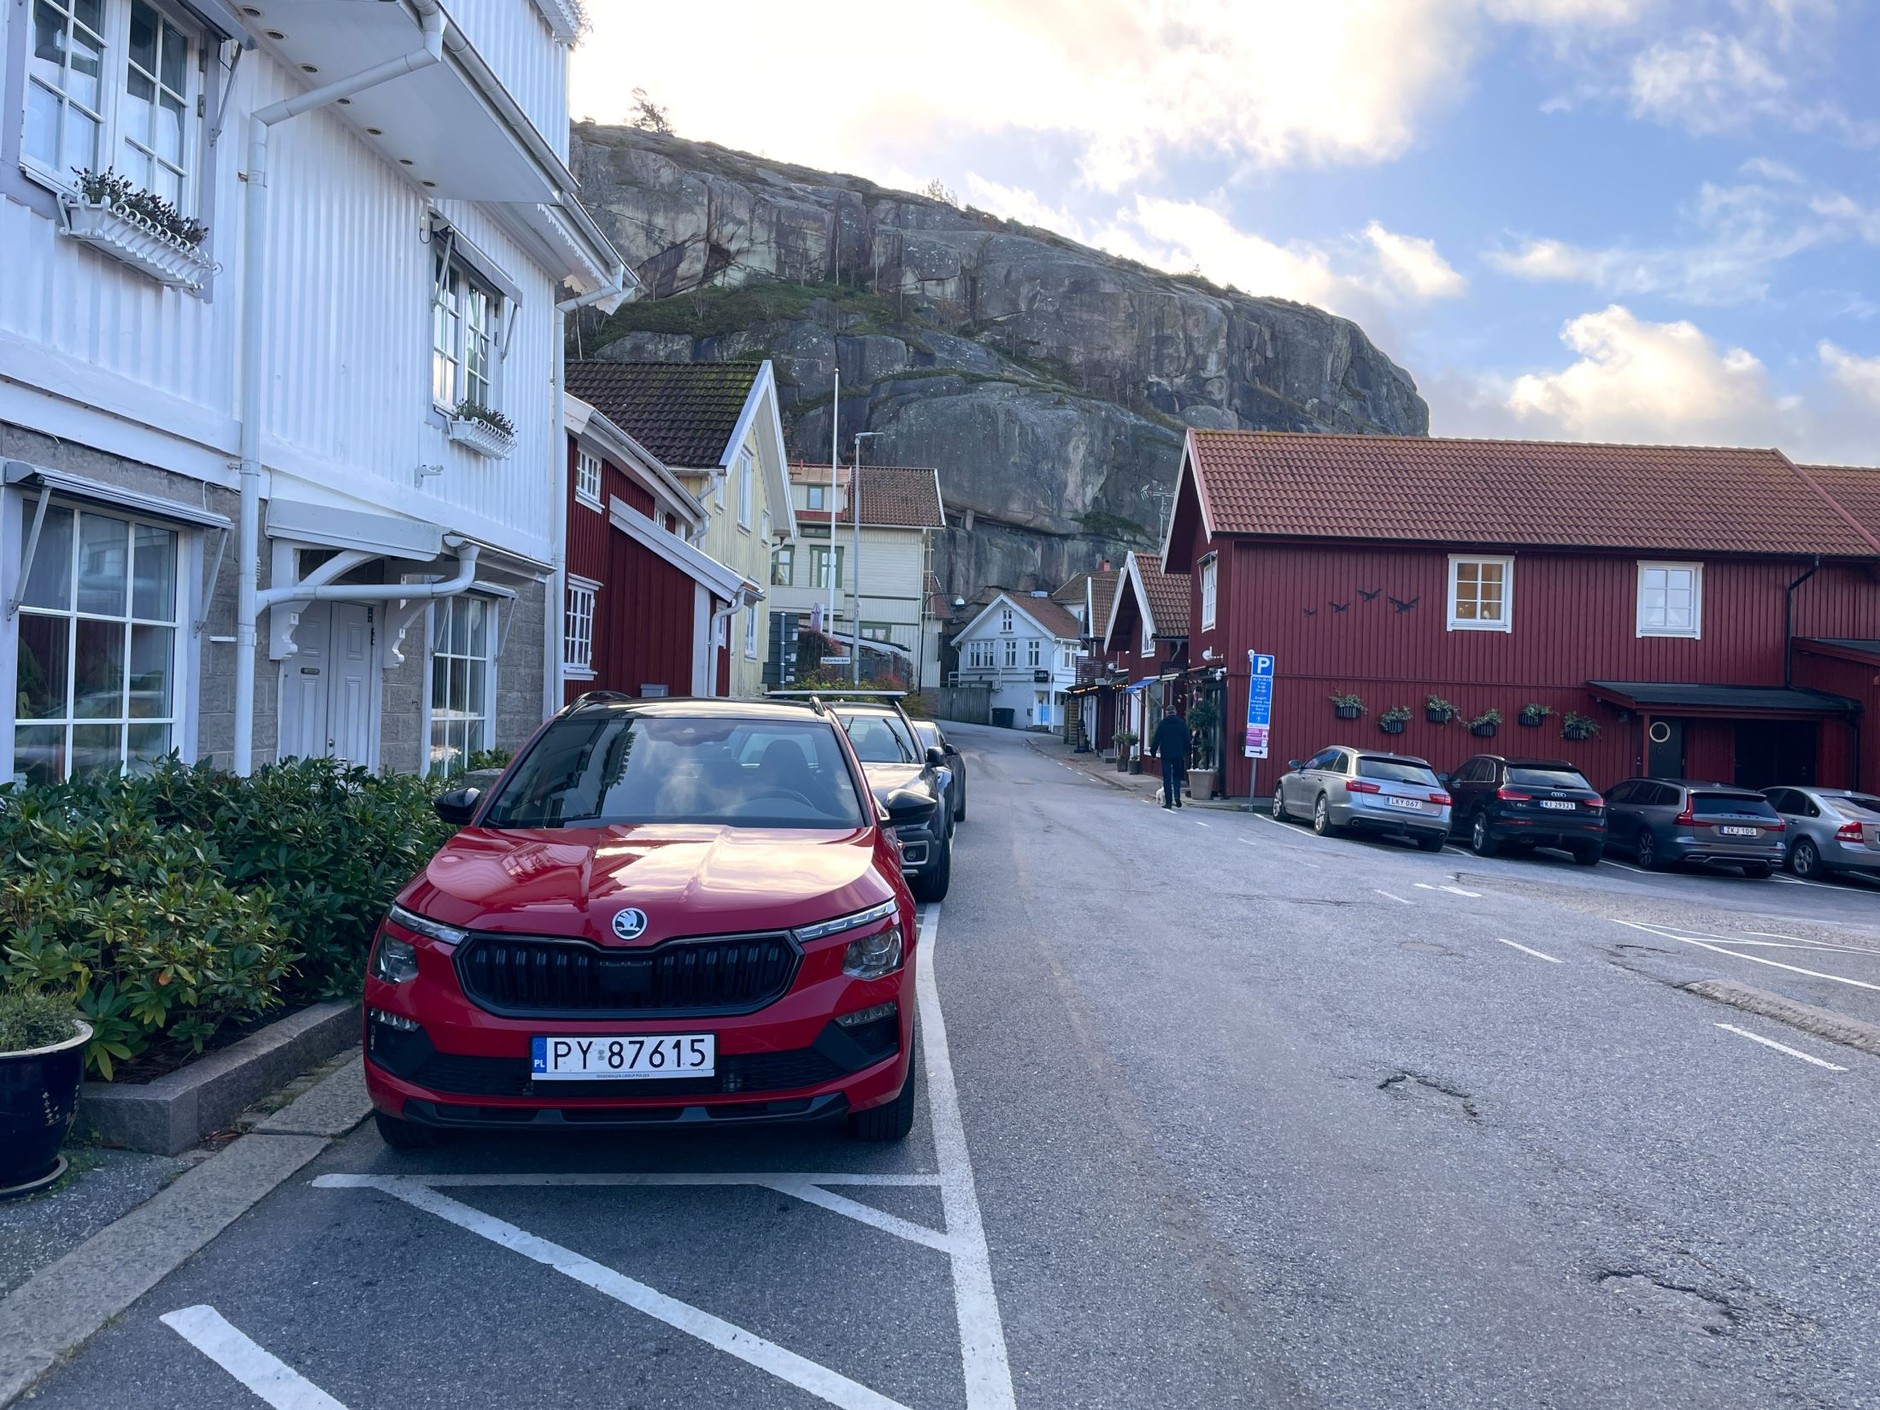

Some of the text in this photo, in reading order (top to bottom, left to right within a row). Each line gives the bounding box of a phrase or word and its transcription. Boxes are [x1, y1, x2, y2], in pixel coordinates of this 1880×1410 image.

[1257, 657, 1270, 674] P
[1391, 797, 1404, 805] LKY
[553, 1038, 706, 1070] PY 87615
[534, 1059, 545, 1068] PL
